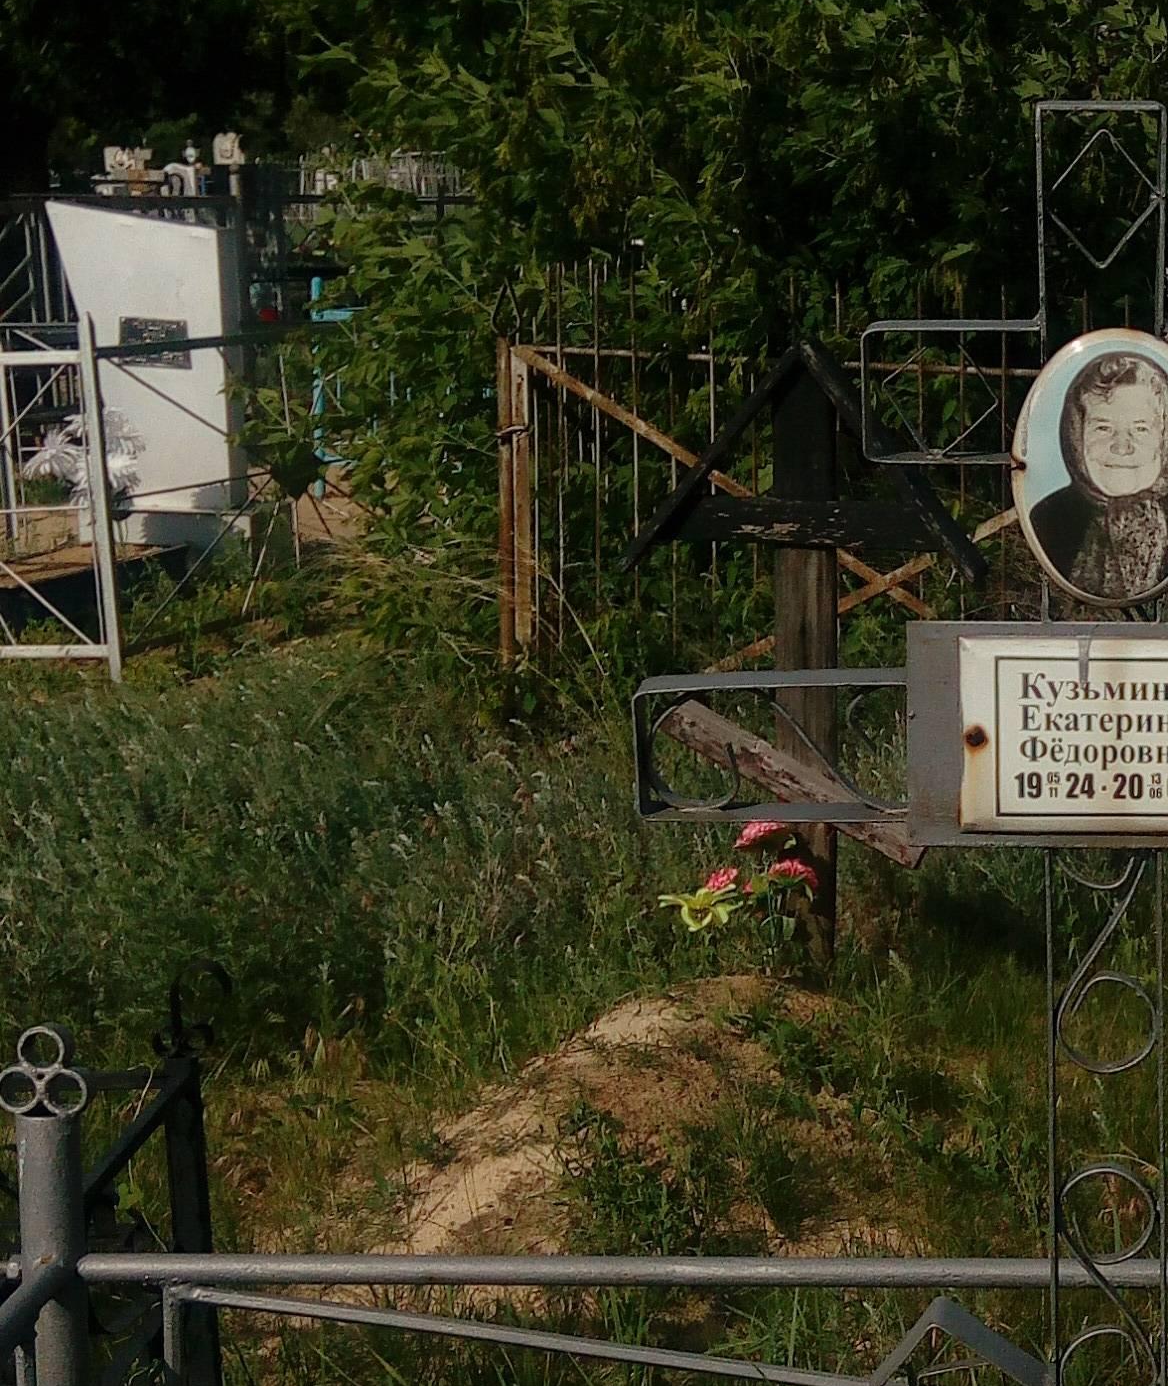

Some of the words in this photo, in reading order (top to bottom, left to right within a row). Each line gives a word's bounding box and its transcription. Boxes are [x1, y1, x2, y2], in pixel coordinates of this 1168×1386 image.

[1014, 772, 1042, 798] 19
[1066, 773, 1095, 799] 24
[1112, 773, 1143, 799] 20
